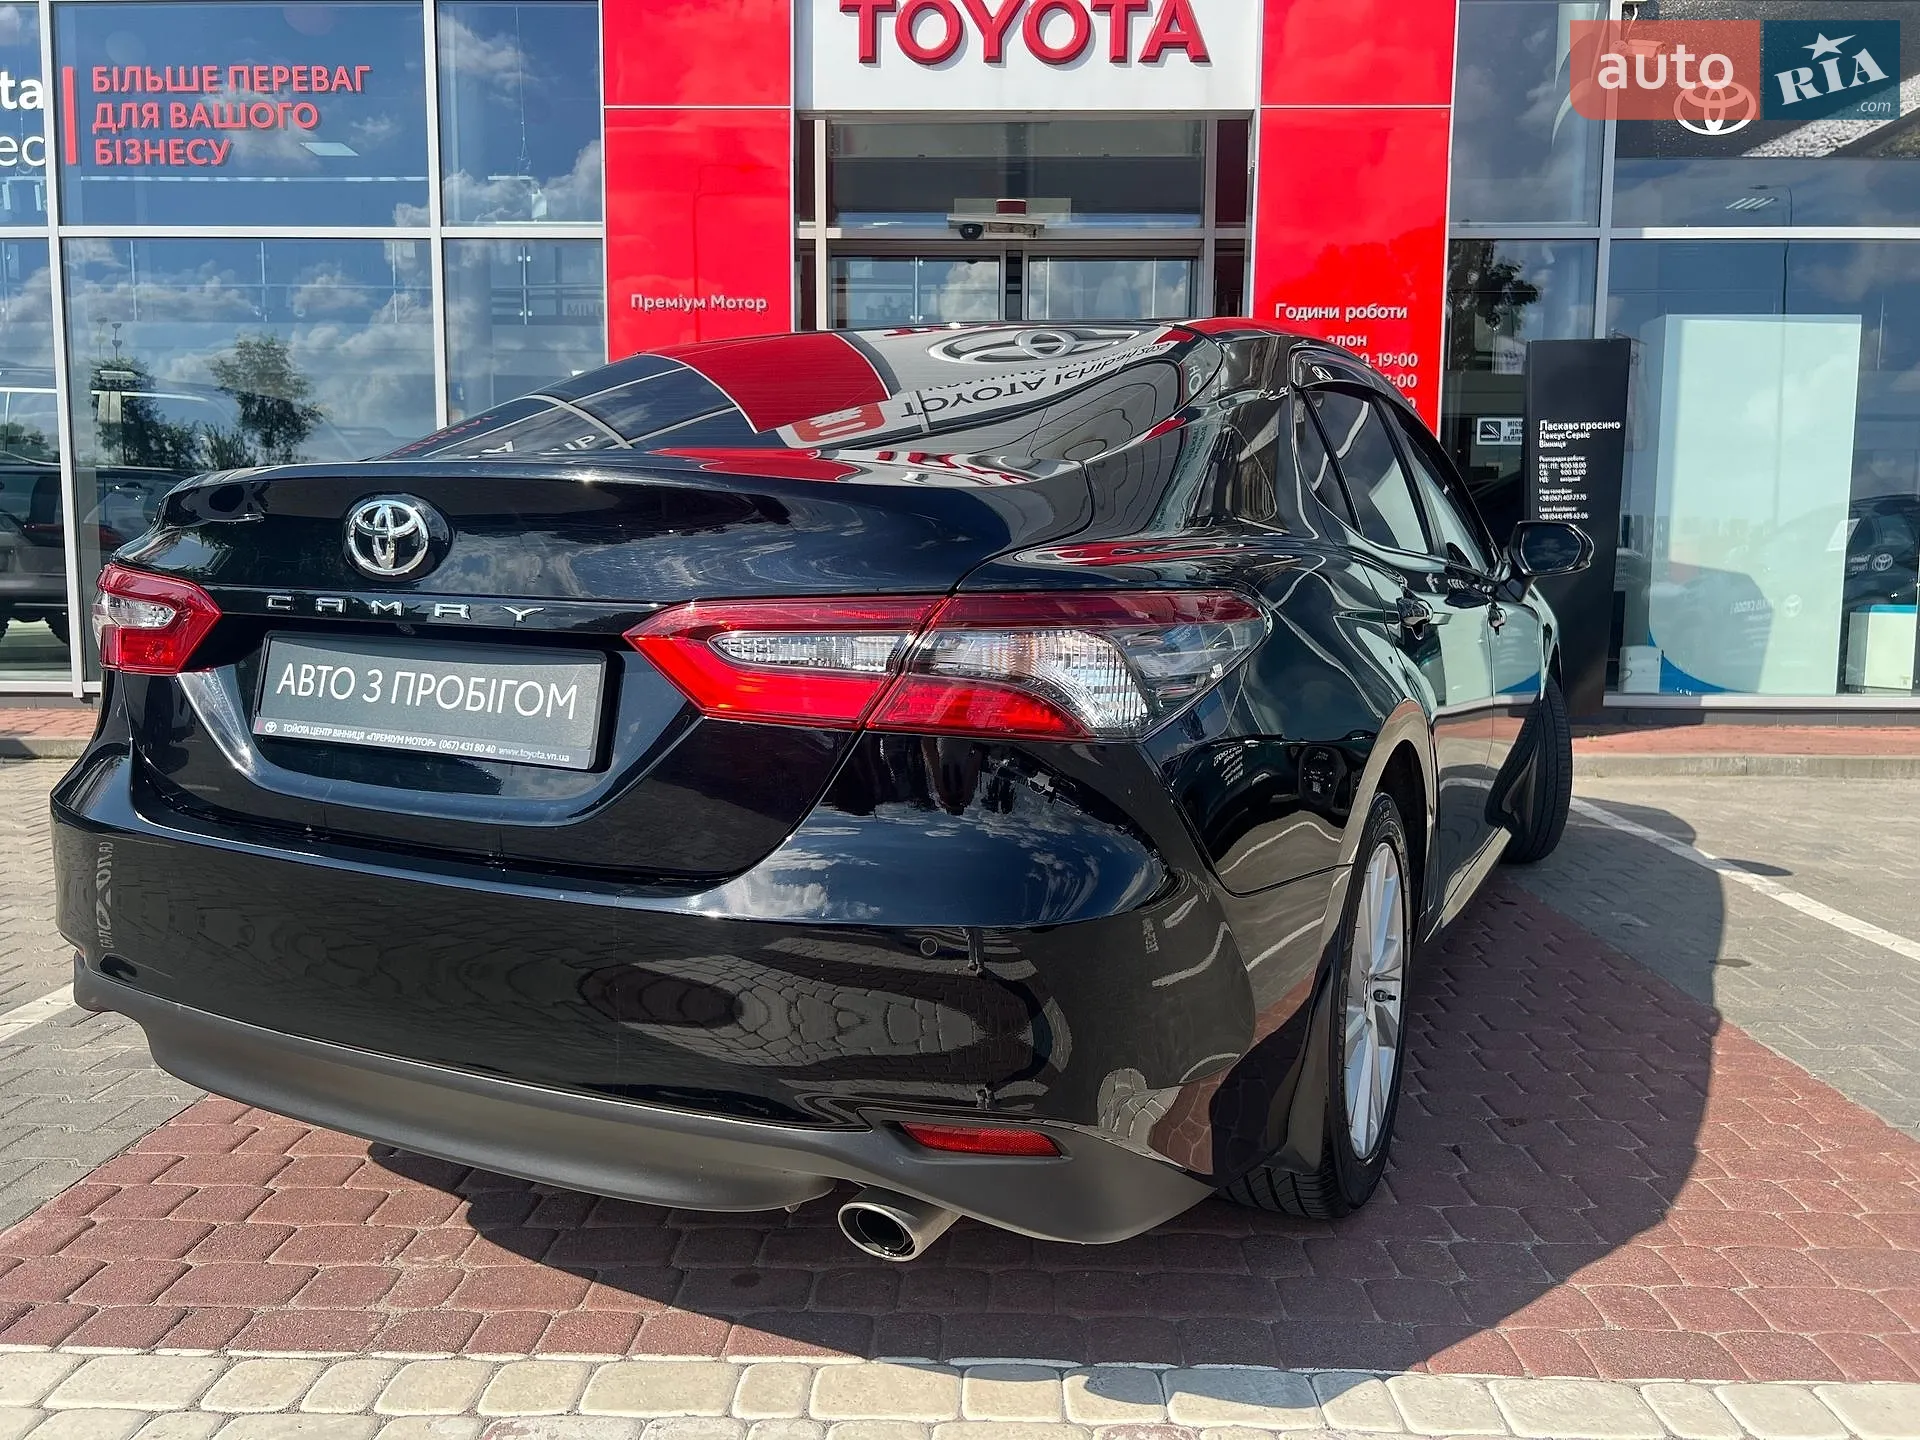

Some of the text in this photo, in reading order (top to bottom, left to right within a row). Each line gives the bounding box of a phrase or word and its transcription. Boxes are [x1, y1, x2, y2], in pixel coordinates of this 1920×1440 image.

[839, 0, 1212, 65] TOYOTA
[0, 71, 44, 110] ta
[91, 65, 372, 93] БІЛЬШЕ ПЕРЕВАГ
[91, 102, 320, 134] ДЛЯ ВАШОГО
[95, 138, 233, 166] БІЗНЕСУ
[631, 293, 768, 313] Преміум Мотор
[1275, 303, 1408, 322] Години роботи
[1324, 334, 1368, 348] алон
[1360, 352, 1419, 368] 0-19:00
[1539, 419, 1621, 432] Ласкаво просимо
[266, 594, 546, 623] CAMRY
[276, 662, 356, 700] АВТО
[390, 670, 579, 721] ПРОБІГОМ
[283, 722, 310, 735] ТОЙОТА
[310, 726, 333, 737] ЦЕНТР
[332, 728, 365, 741] ВІННИЦЯ
[438, 739, 460, 751] (067)
[459, 741, 475, 752] 431
[475, 743, 485, 753] 80
[485, 743, 497, 754] 40
